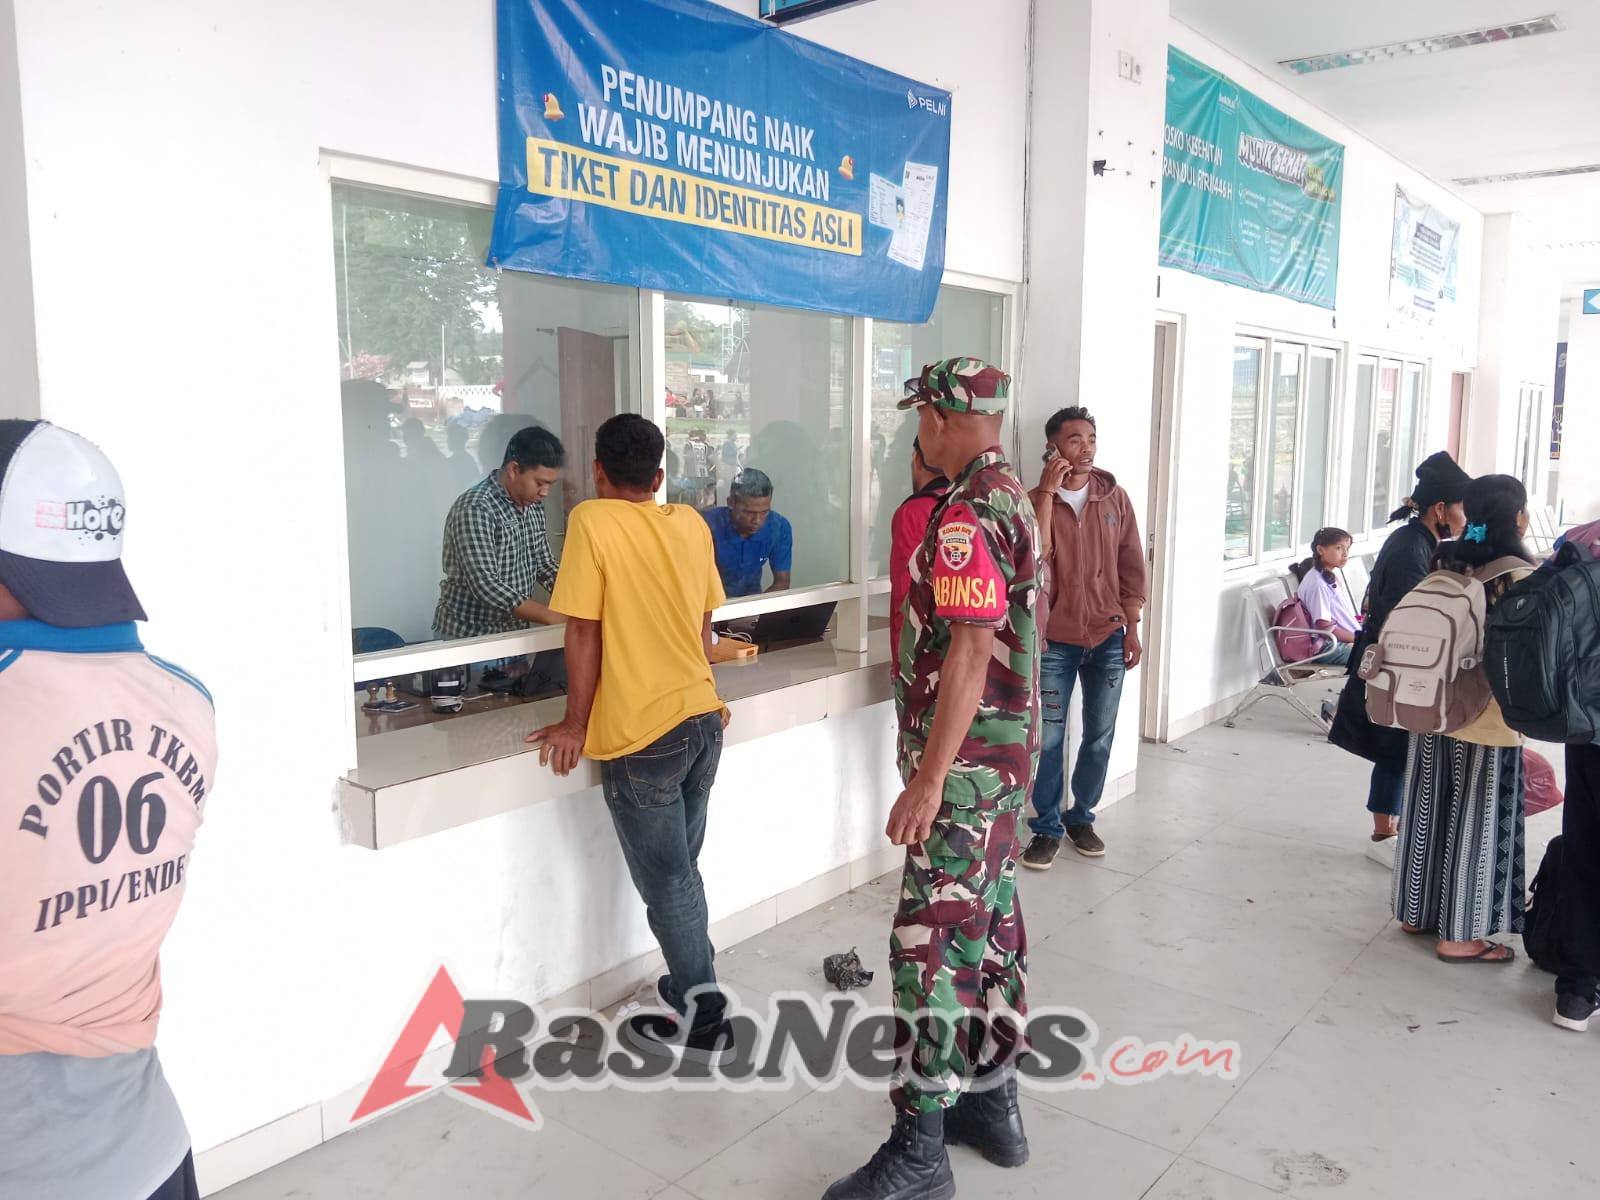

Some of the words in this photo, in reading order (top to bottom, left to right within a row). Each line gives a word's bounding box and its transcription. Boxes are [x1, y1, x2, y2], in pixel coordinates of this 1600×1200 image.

[577, 103, 669, 161] WAJIB
[676, 131, 829, 201] MENUNJUKAN
[601, 63, 758, 145] PENUMPANG
[764, 116, 815, 161] NAIK
[918, 96, 946, 117] PELNI
[1164, 123, 1184, 151] OSKO
[538, 146, 619, 201] TIKET
[630, 169, 686, 216] DAN
[695, 185, 807, 240] IDENTITAS
[811, 214, 853, 249] ASLI
[65, 501, 125, 531] Hore
[933, 575, 997, 609] ABINSA
[19, 718, 134, 840] PORTIR
[147, 723, 205, 810] TKBM
[77, 771, 167, 864] 06
